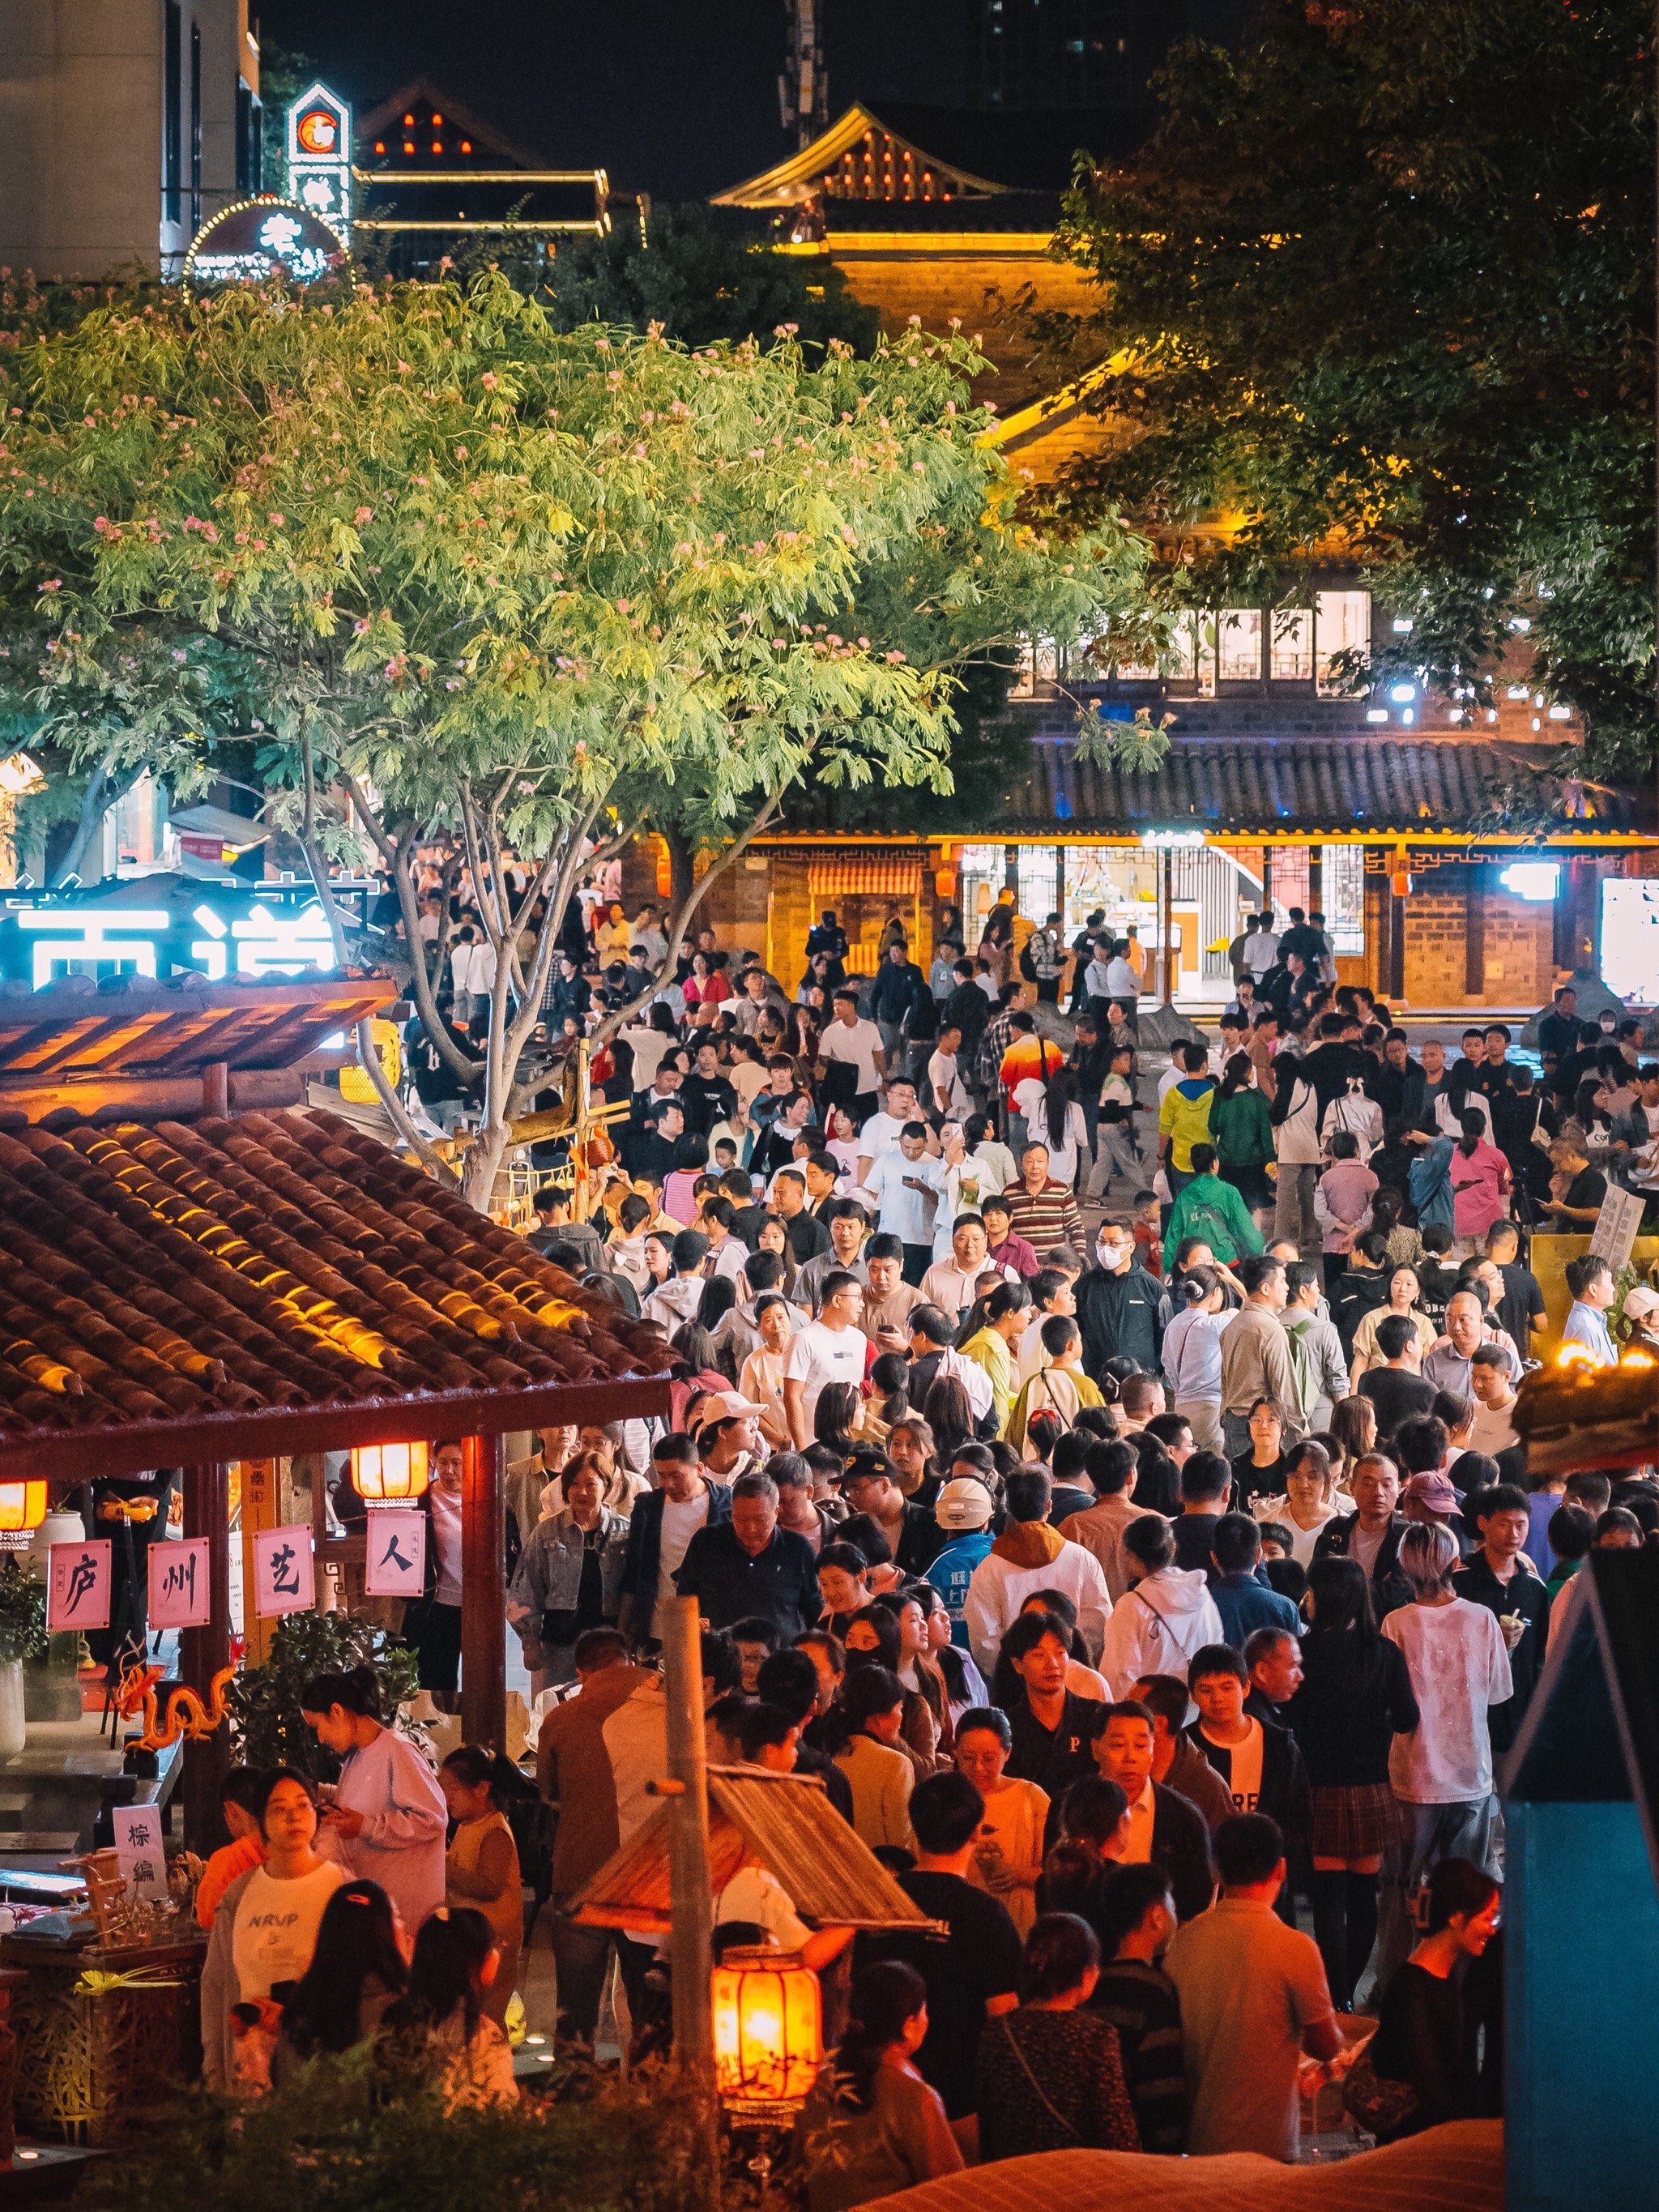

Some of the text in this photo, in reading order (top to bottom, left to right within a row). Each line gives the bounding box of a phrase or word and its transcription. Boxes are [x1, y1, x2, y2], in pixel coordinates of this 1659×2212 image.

[64, 1553, 98, 1618] 庐
[163, 1552, 197, 1613] 州
[270, 1544, 301, 1595] 艺
[377, 1534, 414, 1572] 人
[1069, 1736, 1080, 1753] P
[127, 1823, 155, 1882] 棕编
